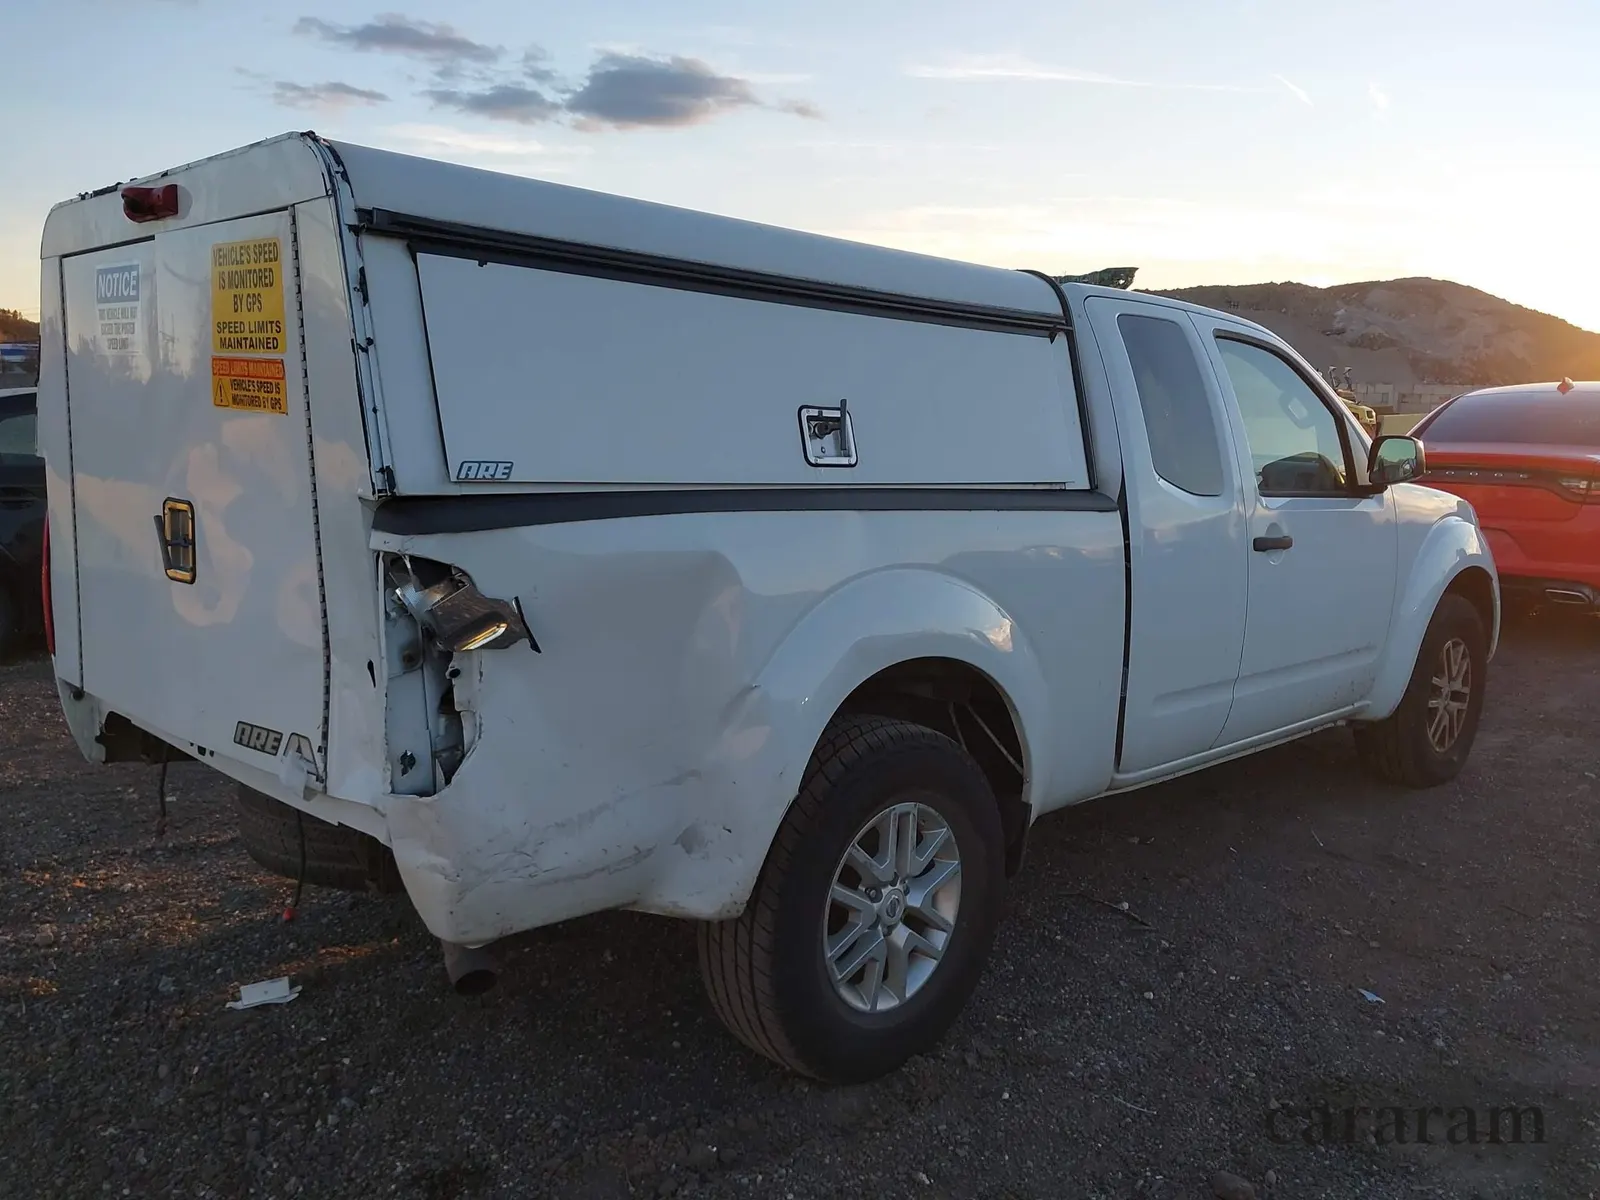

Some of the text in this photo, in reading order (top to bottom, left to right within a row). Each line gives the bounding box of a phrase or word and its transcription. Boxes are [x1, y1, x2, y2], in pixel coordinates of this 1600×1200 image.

[213, 242, 279, 267] VEHICLE'S SPEED
[97, 270, 137, 298] NOTICE
[218, 267, 274, 290] IS MONITORED
[233, 293, 263, 313] BY GPS
[217, 320, 282, 334] SPEED LIMITS
[220, 337, 279, 350] MAINTAINED
[256, 380, 274, 395] SPEED
[275, 381, 281, 395] IS
[231, 393, 262, 408] MONITORED
[270, 397, 282, 410] GPS
[457, 461, 513, 480] ARE
[234, 721, 283, 756] ARE
